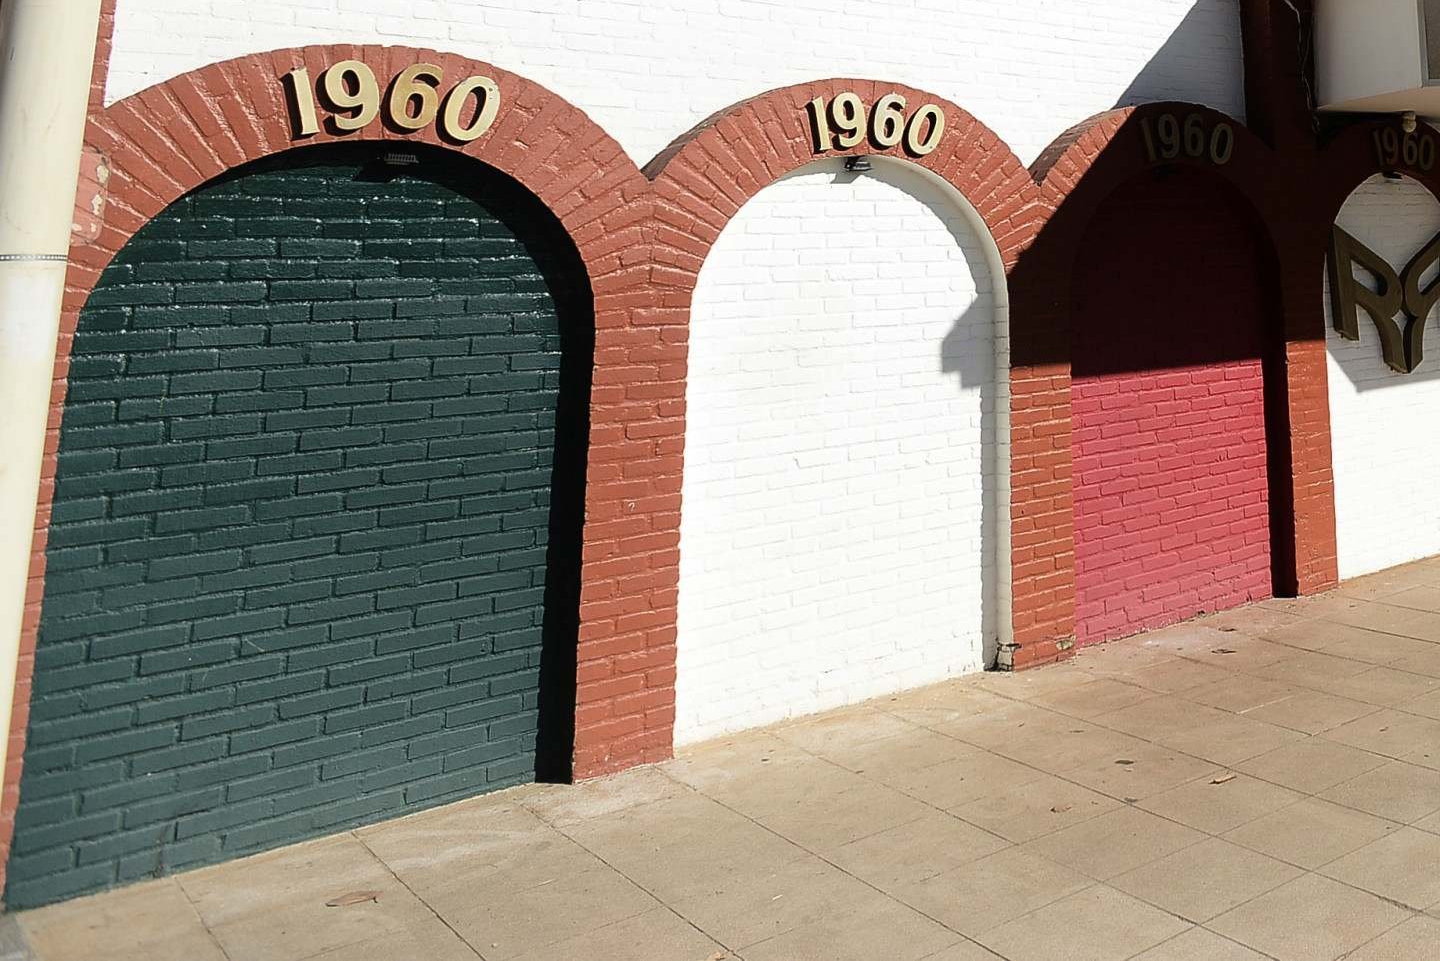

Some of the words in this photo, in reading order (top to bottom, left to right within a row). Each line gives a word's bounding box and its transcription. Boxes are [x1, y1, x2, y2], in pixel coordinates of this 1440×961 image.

[281, 60, 500, 145] 1960
[806, 92, 945, 156] 1960
[1140, 112, 1234, 165] 1960
[1374, 127, 1436, 171] 1960
